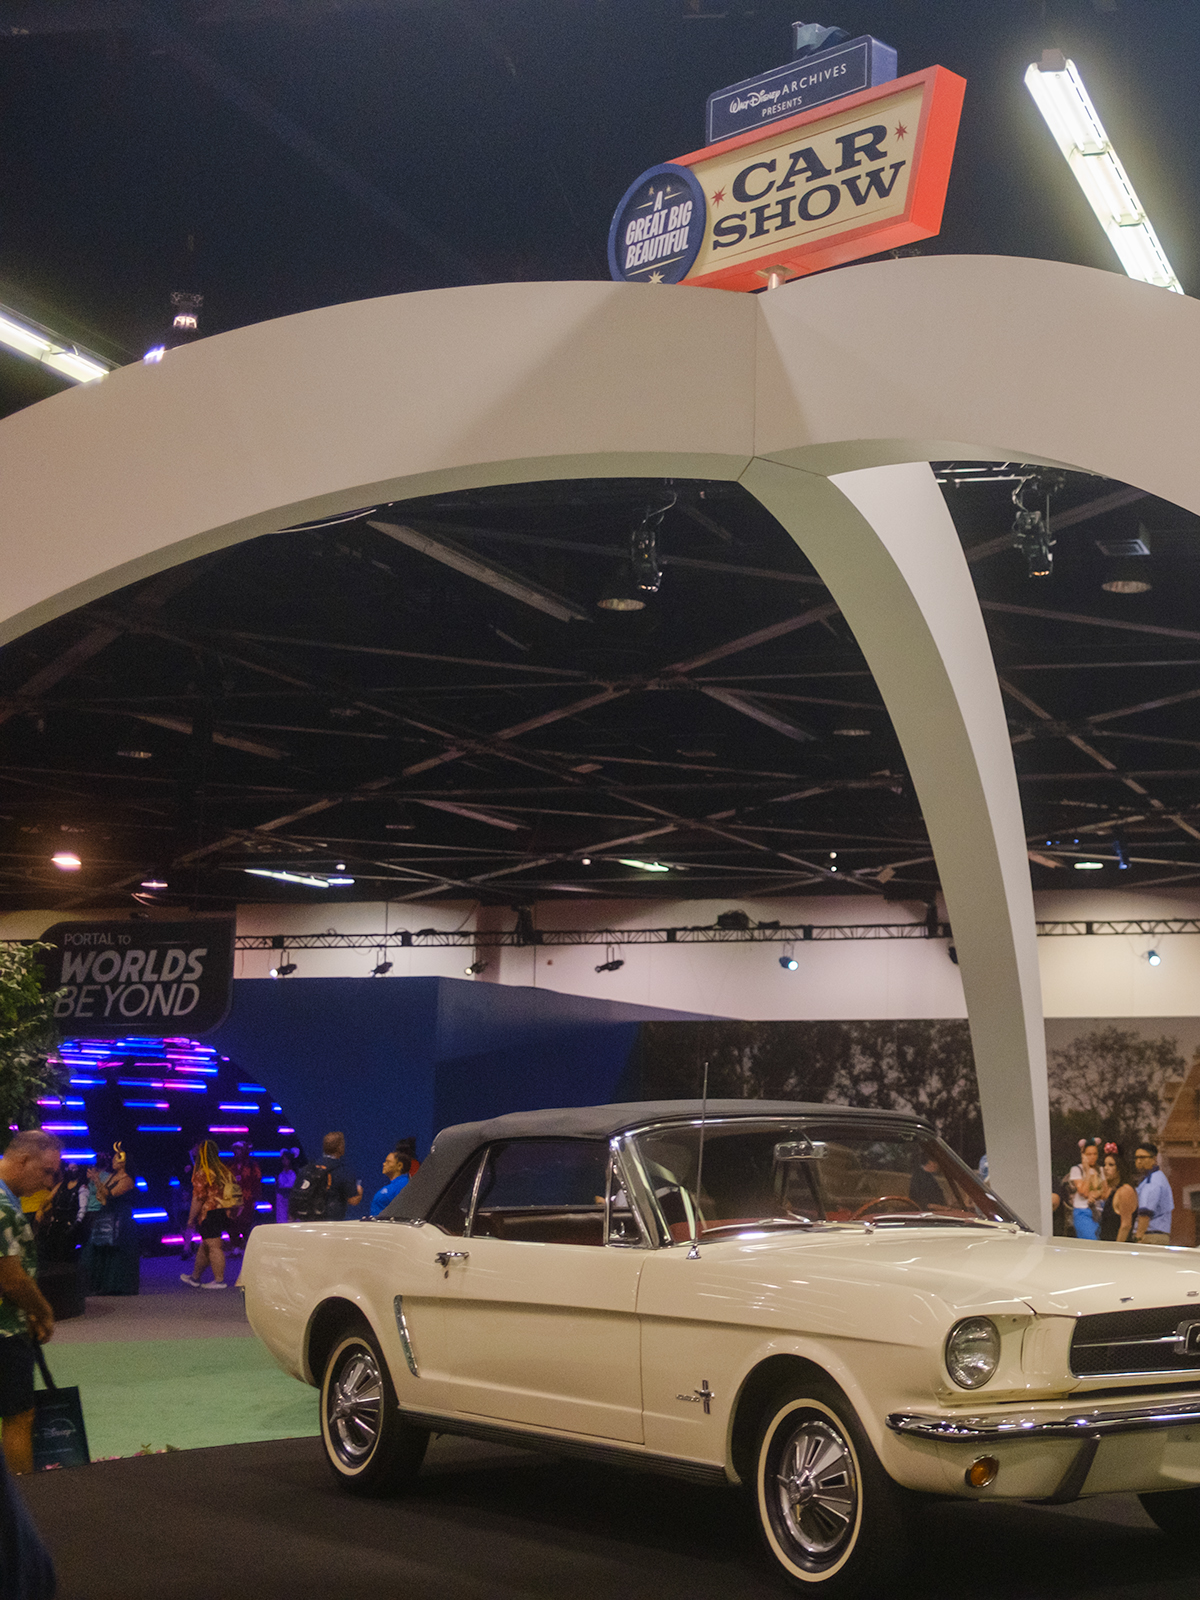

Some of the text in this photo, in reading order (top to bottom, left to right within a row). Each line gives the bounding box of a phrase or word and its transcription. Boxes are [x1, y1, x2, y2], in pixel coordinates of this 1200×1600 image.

[729, 63, 847, 114] Walt Disney ARCHIVES
[761, 96, 803, 117] PRESENTS
[731, 124, 888, 203] CAR
[653, 190, 664, 212] A
[712, 160, 907, 251] SHOW
[625, 200, 693, 246] GREAT BIG
[624, 225, 690, 270] BEAUTIFUL
[63, 932, 132, 946] PORTAL TO
[60, 948, 208, 984] WORLDS
[53, 983, 200, 1018] BEYOND
